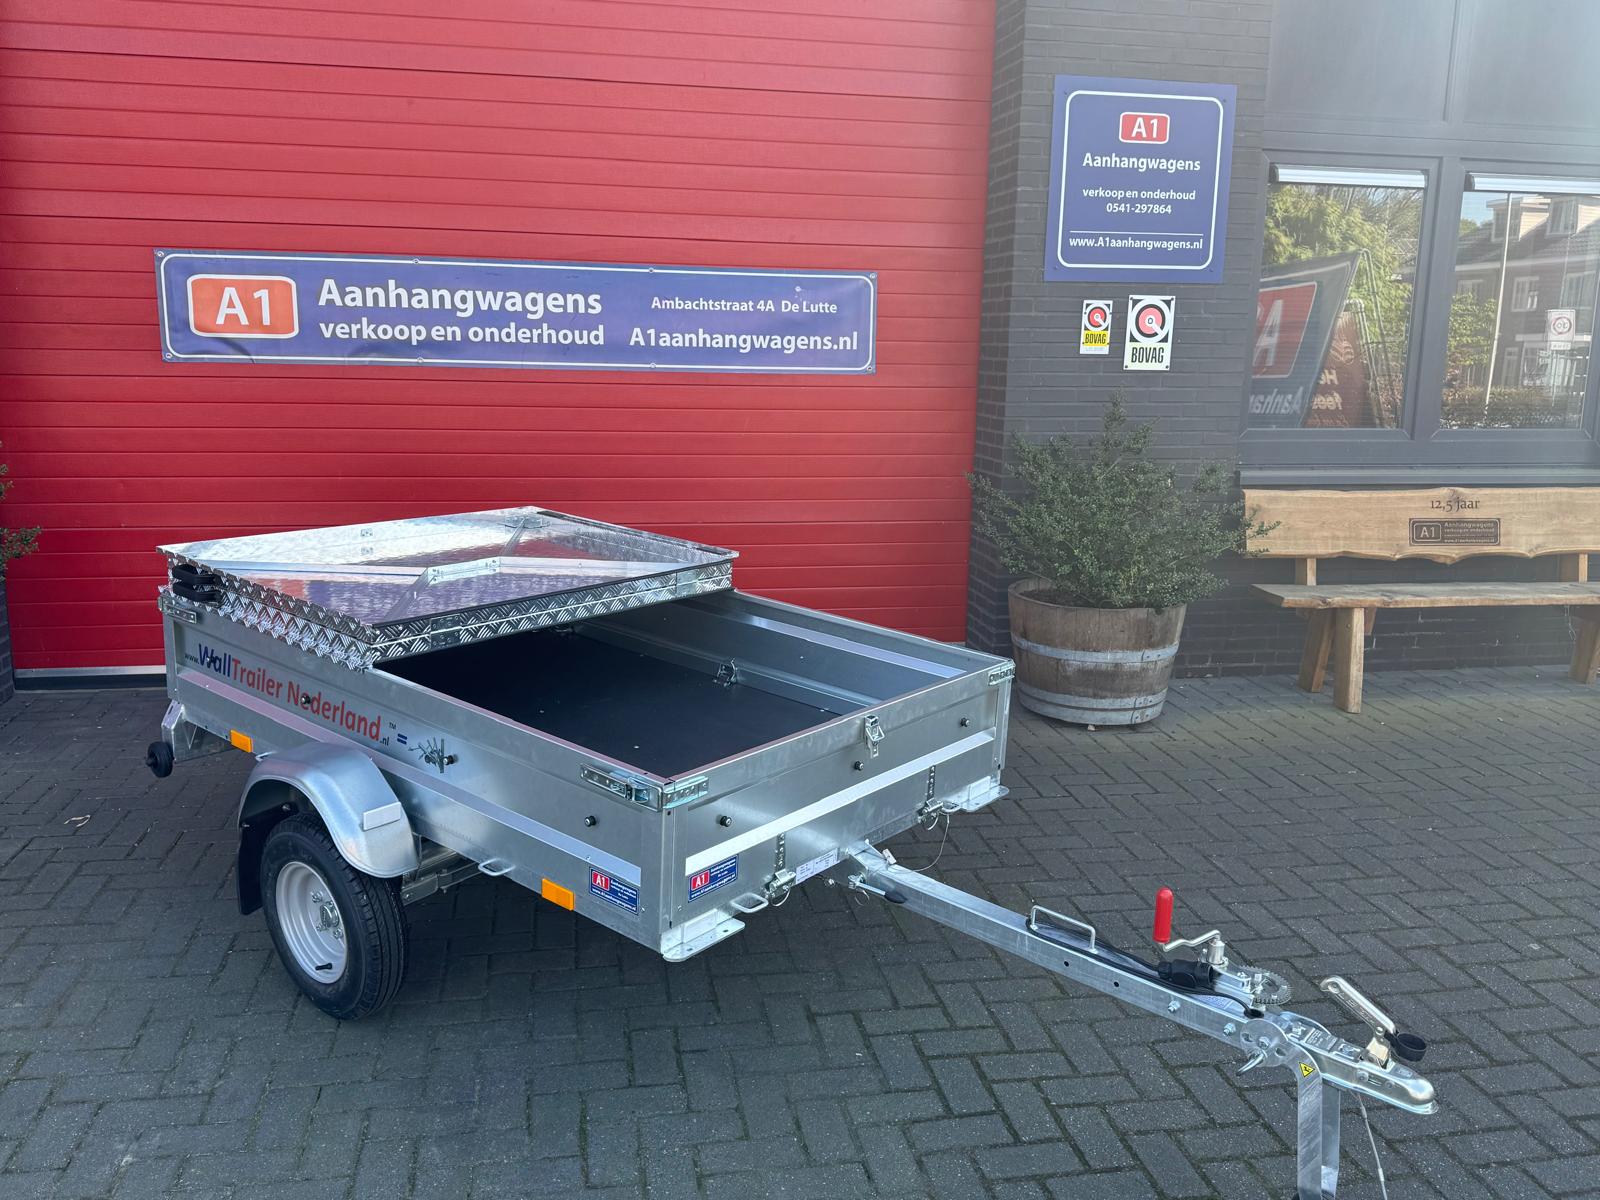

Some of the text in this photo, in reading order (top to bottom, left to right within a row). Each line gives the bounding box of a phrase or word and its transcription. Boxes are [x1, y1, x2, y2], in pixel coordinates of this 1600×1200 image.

[1131, 117, 1159, 138] A1
[1082, 152, 1201, 173] Aanhangwagens
[1082, 187, 1196, 200] verkoop en onderhoud
[1106, 203, 1172, 214] 0541-297864
[1069, 236, 1203, 251] www.A1aanhangwagens.nl
[215, 287, 271, 326] A1
[318, 279, 602, 319] Aanhangwagens
[651, 296, 838, 314] Ambachtstraat 4A De Lutte
[319, 317, 605, 346] verkoop en onderhoud
[1084, 333, 1107, 345] BOVAG
[629, 327, 858, 354] A1aanhangwagens.nl
[1131, 347, 1165, 363] BOVAG
[1431, 497, 1480, 512] 12,5 jaar
[1420, 527, 1436, 538] A1
[596, 875, 606, 888] A1
[696, 874, 706, 888] A1
